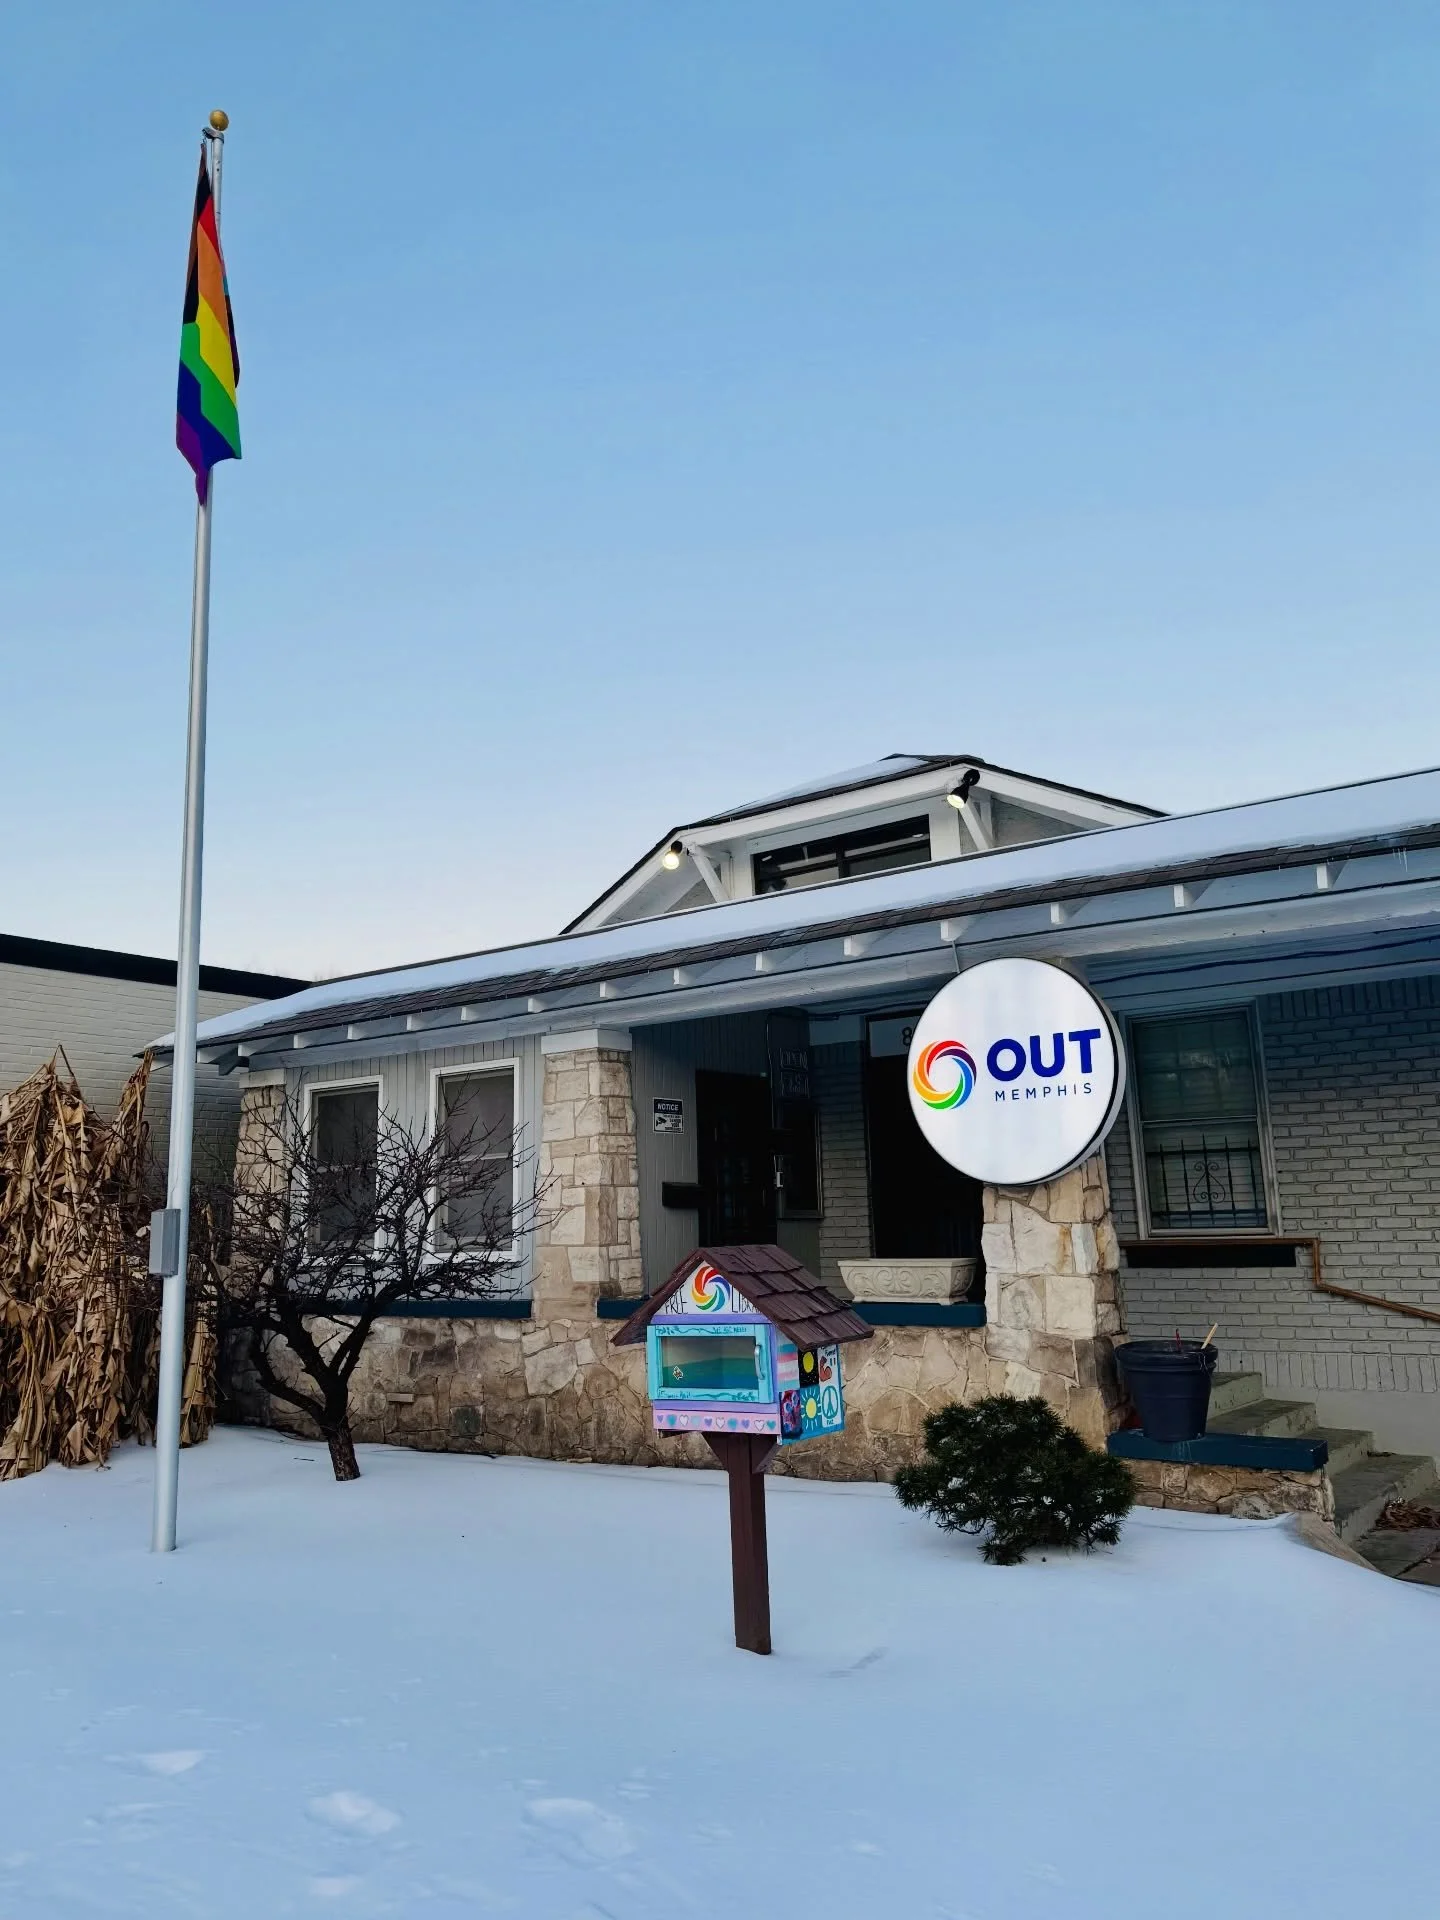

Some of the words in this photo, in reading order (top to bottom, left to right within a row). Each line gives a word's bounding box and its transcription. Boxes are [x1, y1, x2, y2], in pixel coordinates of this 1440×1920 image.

[987, 1028, 1101, 1082] OUT
[995, 1083, 1092, 1101] MEMPHIS
[657, 1103, 679, 1111] NOTICE
[664, 1285, 689, 1315] FREE
